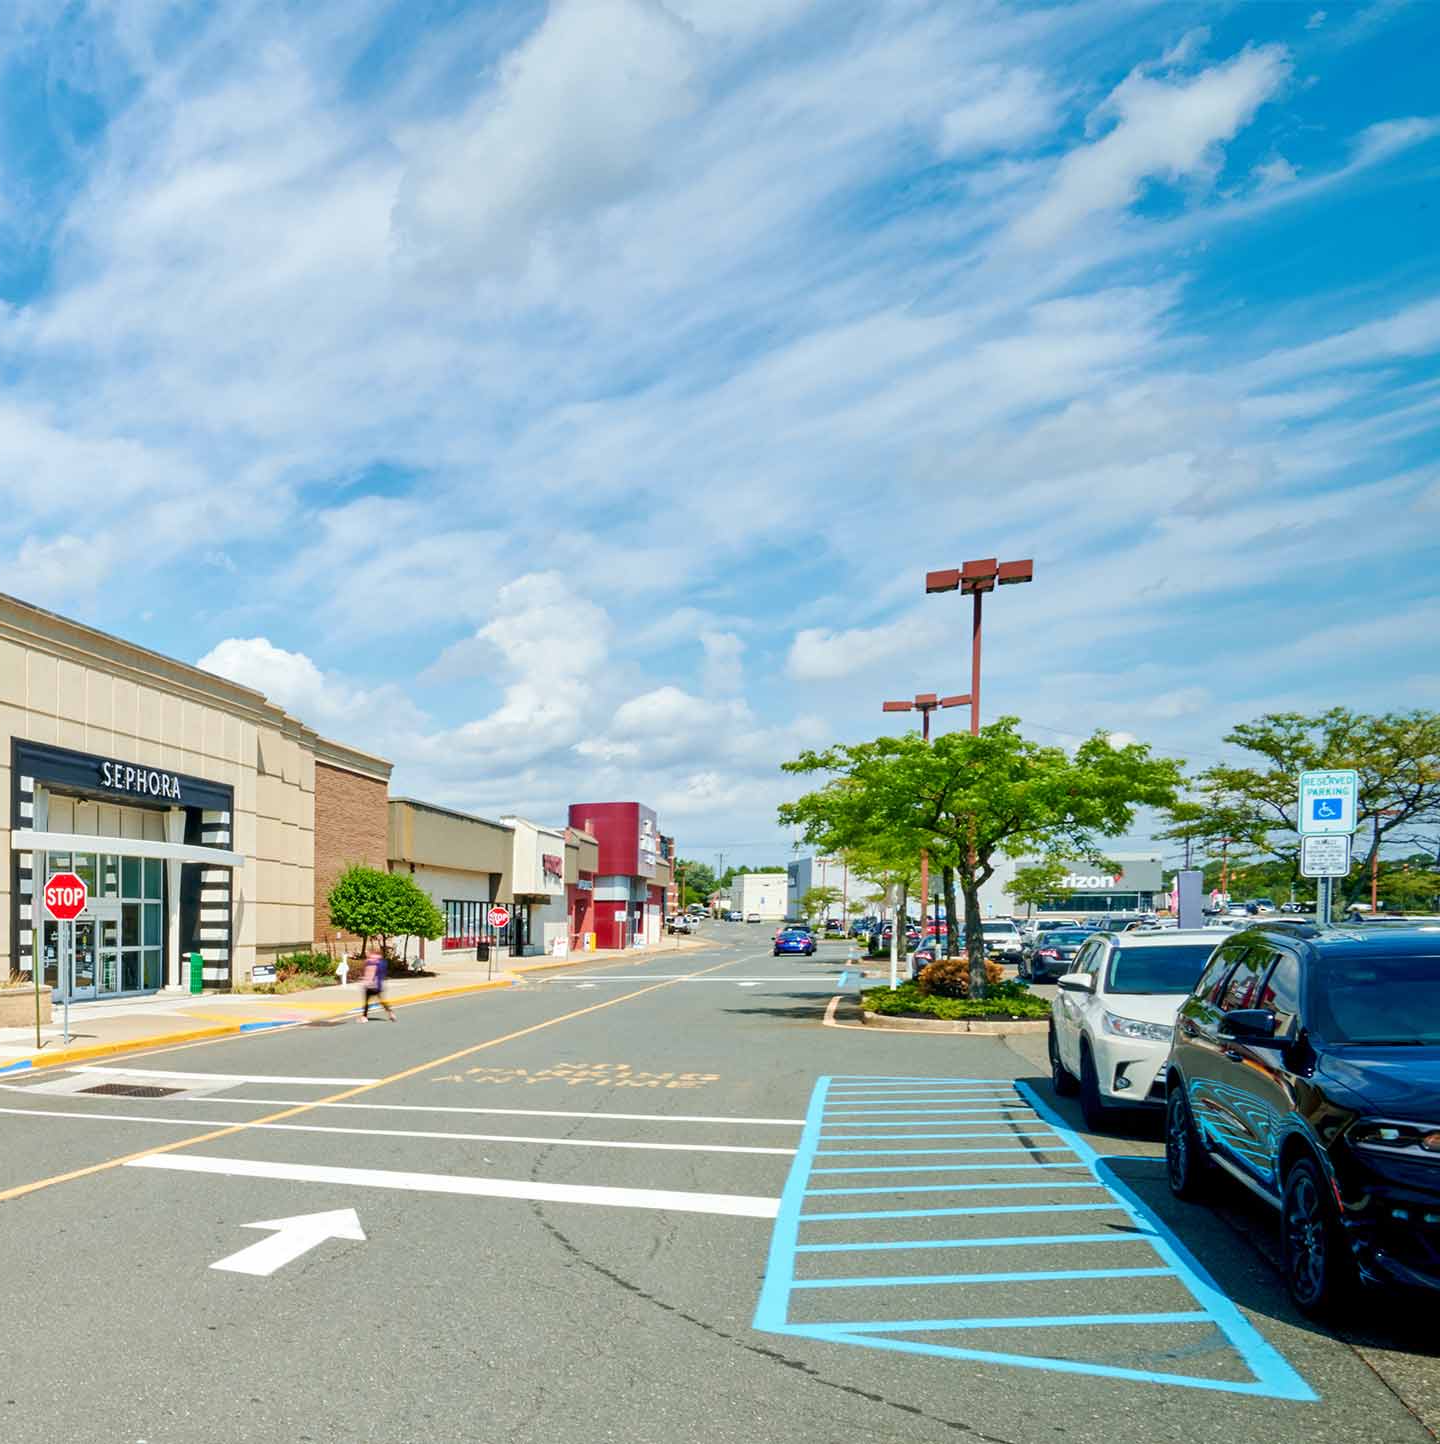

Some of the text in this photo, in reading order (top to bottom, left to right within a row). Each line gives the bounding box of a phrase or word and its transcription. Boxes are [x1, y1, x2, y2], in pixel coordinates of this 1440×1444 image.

[102, 761, 181, 799] SEPHORA
[1303, 776, 1352, 786] RESERVED
[1307, 787, 1350, 796] PARKING
[1048, 872, 1115, 888] rizon
[47, 887, 84, 906] STOP
[489, 912, 508, 924] STOP
[554, 1063, 632, 1071] NO
[466, 1067, 720, 1081] PARKING
